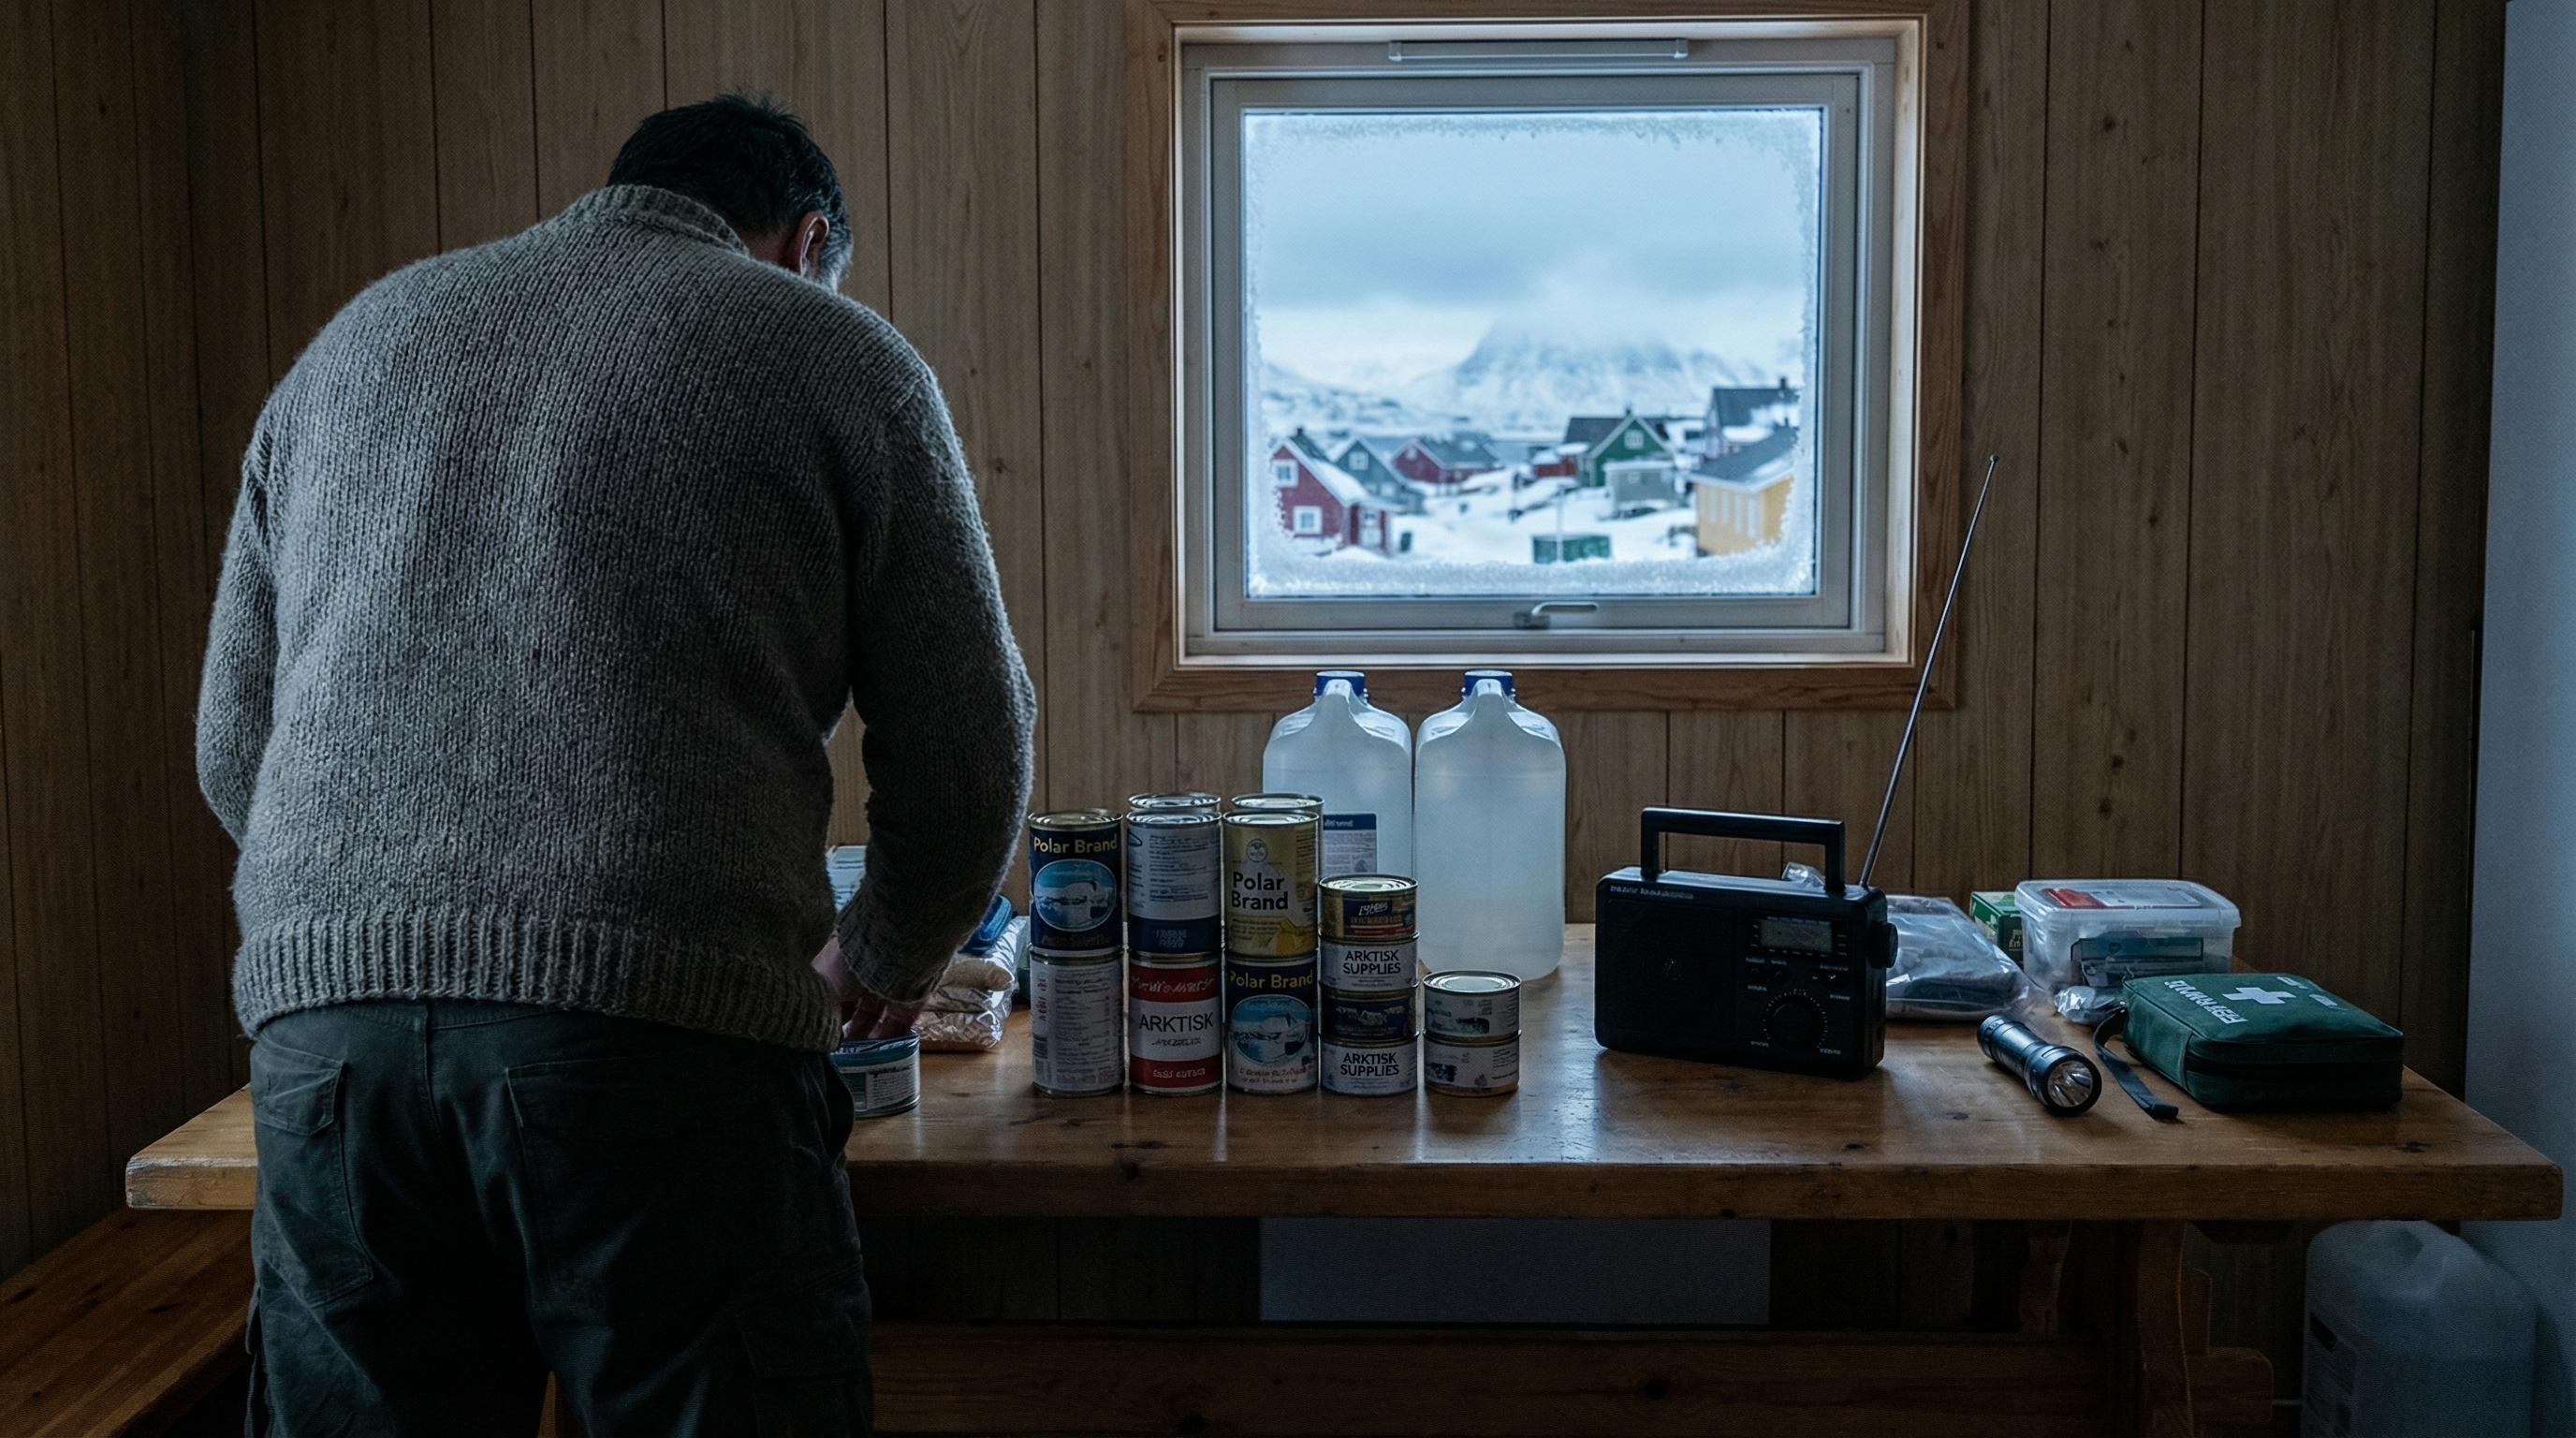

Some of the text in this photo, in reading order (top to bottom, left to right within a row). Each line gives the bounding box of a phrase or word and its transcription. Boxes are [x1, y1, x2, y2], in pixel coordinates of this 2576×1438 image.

[1033, 832, 1118, 854] Polar Brand
[1233, 872, 1285, 890] Polar
[1231, 889, 1289, 910] Brand
[1270, 968, 1313, 989] Brand
[1138, 1011, 1214, 1033] ARKTISK
[1339, 1064, 1399, 1077] SUPPLIES
